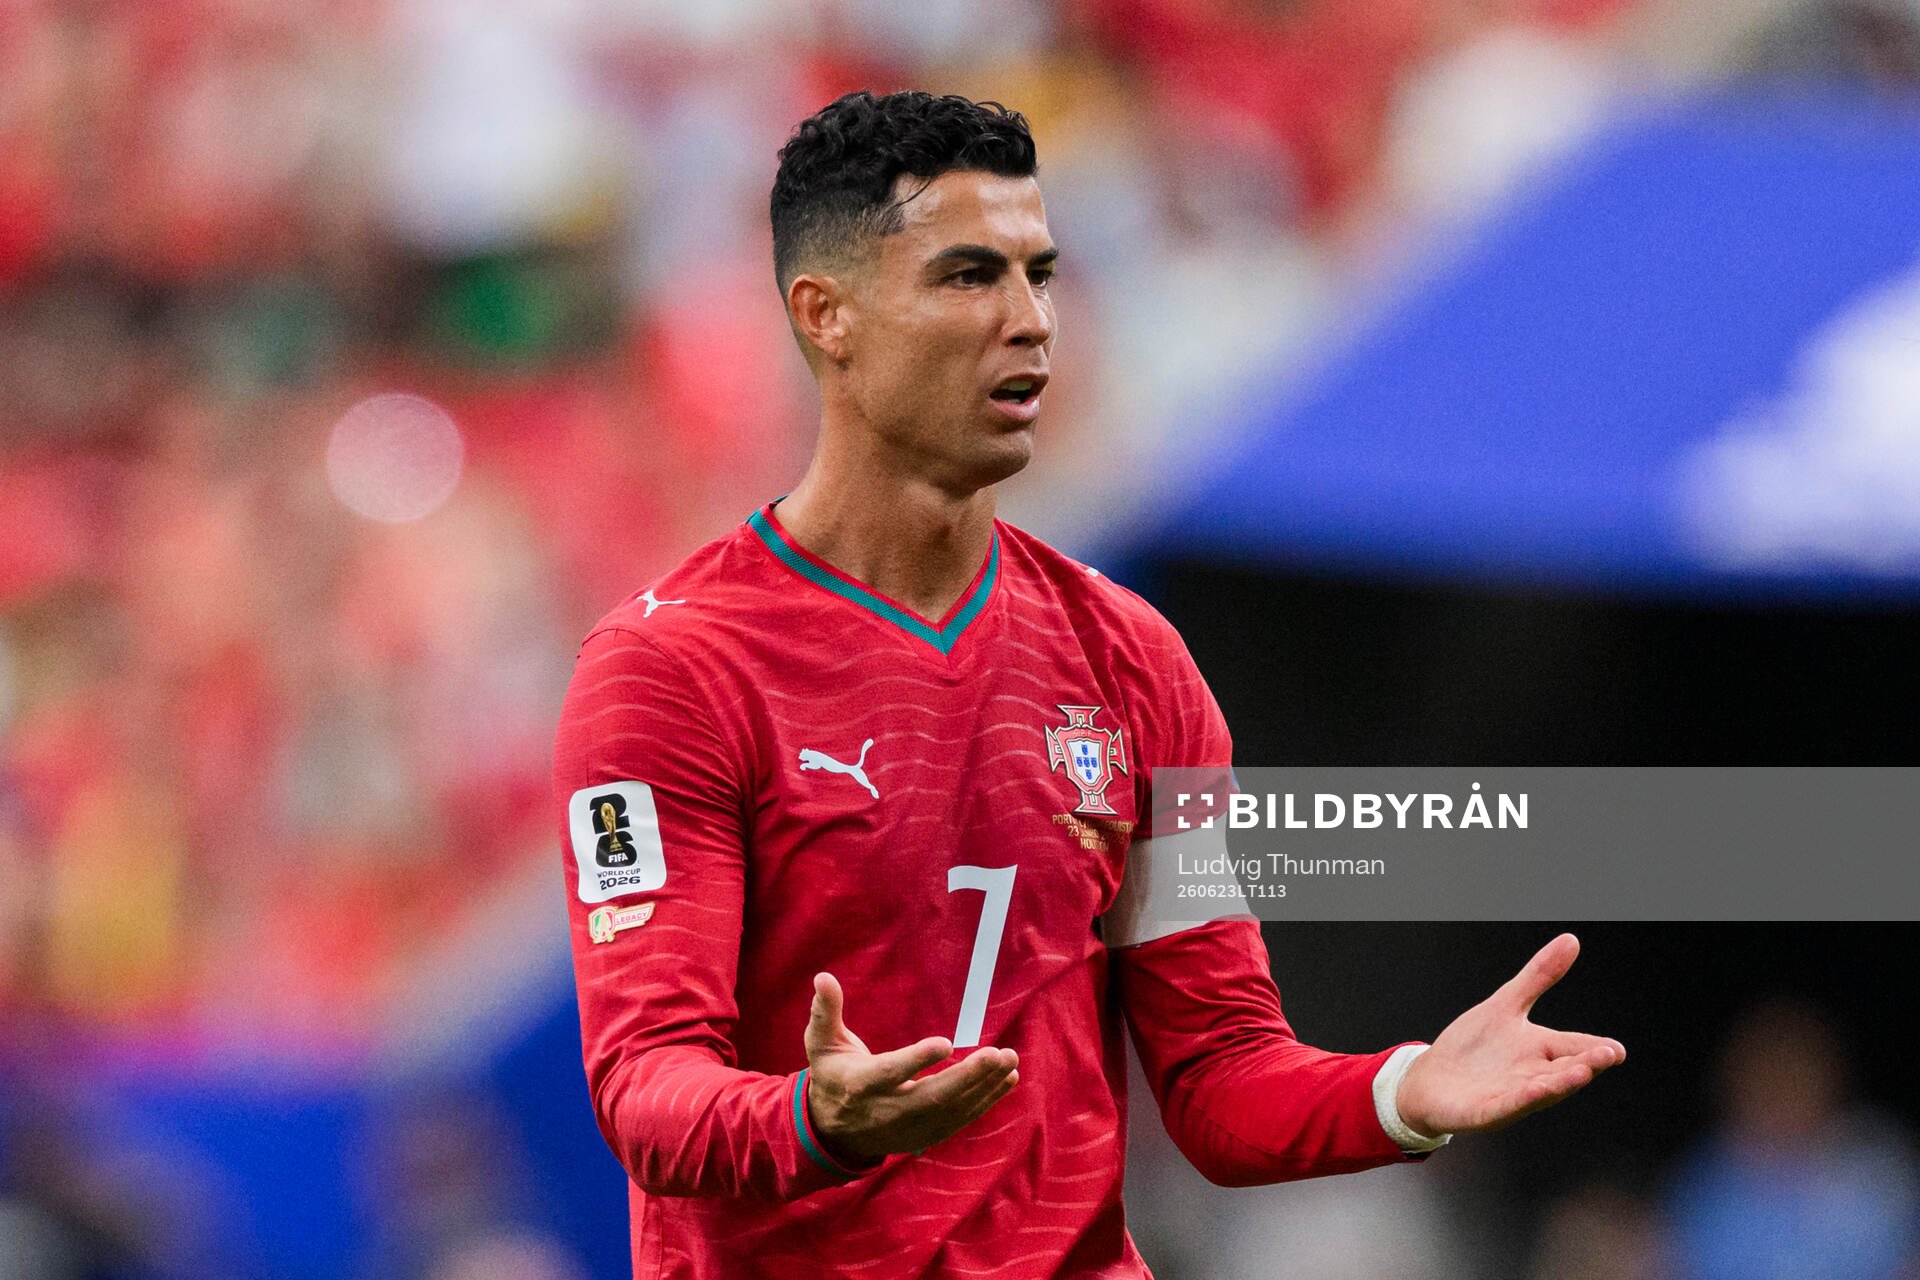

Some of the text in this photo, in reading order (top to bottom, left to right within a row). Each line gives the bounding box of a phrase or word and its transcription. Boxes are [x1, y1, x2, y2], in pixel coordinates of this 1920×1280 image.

[608, 852, 629, 864] FIFA
[597, 868, 641, 879] WORLD CUP
[600, 876, 641, 891] 2026
[616, 911, 648, 924] LEGACY
[947, 864, 1018, 1048] 7
